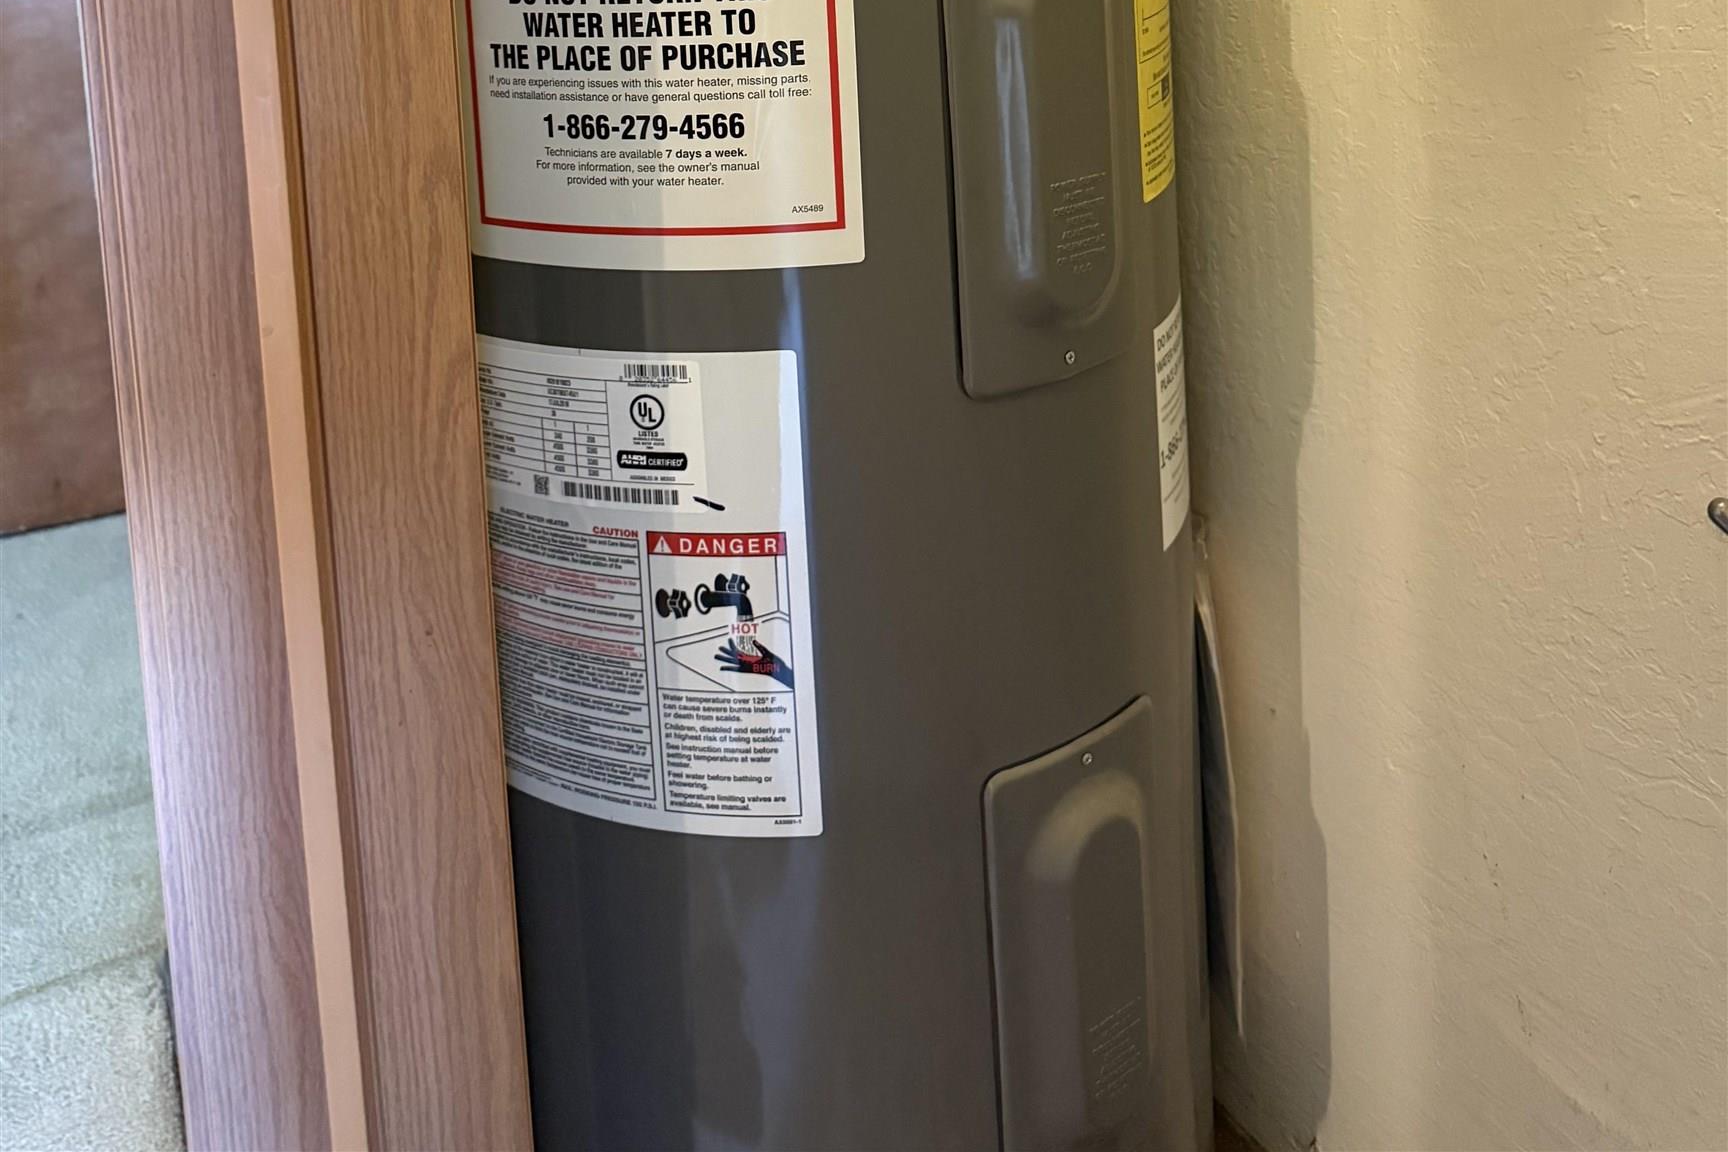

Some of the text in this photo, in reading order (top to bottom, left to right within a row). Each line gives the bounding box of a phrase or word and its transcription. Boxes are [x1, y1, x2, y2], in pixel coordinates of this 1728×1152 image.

[523, 8, 756, 38] WATER HEATER TO
[489, 40, 806, 71] THE PLACE OF PURCHASE
[489, 75, 495, 84] If
[496, 76, 511, 87] you
[512, 78, 527, 86] are
[528, 78, 585, 90] experiencing
[587, 79, 619, 89] issues
[621, 79, 642, 88] with
[645, 78, 663, 88] this
[665, 79, 694, 88] water
[697, 77, 734, 88] heater,
[737, 75, 778, 87] missing
[490, 87, 812, 104] need installation assistance or have general questions call toll free:
[543, 112, 745, 140] 1-866-279-4566
[544, 147, 598, 159] Technicians
[600, 150, 617, 159] are
[619, 150, 663, 159] available
[666, 150, 673, 159] 7
[675, 149, 702, 161] days
[714, 148, 748, 158] week.
[536, 159, 760, 174] For more information, see the owner's manual
[567, 175, 725, 189] provided with your water heater.
[638, 401, 657, 423] UL
[592, 526, 639, 538] CAUTION
[679, 538, 777, 554] DANGER
[731, 623, 760, 634] HOT
[752, 663, 780, 673] BURN
[662, 693, 684, 702] Water
[686, 695, 731, 705] temperature
[673, 712, 694, 720] death
[754, 706, 787, 714] instantly
[664, 723, 699, 733] Children,
[700, 726, 731, 734] disabled
[750, 727, 776, 736] elderly
[674, 732, 701, 741] highest
[703, 734, 717, 742] risk
[729, 735, 750, 744] being
[666, 742, 779, 754] See instruction manual before
[667, 752, 692, 762] setting
[693, 754, 739, 763] temperature
[668, 770, 683, 778] Feel
[707, 774, 732, 782] before
[733, 775, 762, 784] bathing
[668, 780, 708, 791] showering.
[669, 790, 716, 801] Temperature
[717, 794, 746, 804] limiting
[747, 795, 772, 803] valves
[670, 800, 704, 809] available,
[721, 803, 752, 811] manual.
